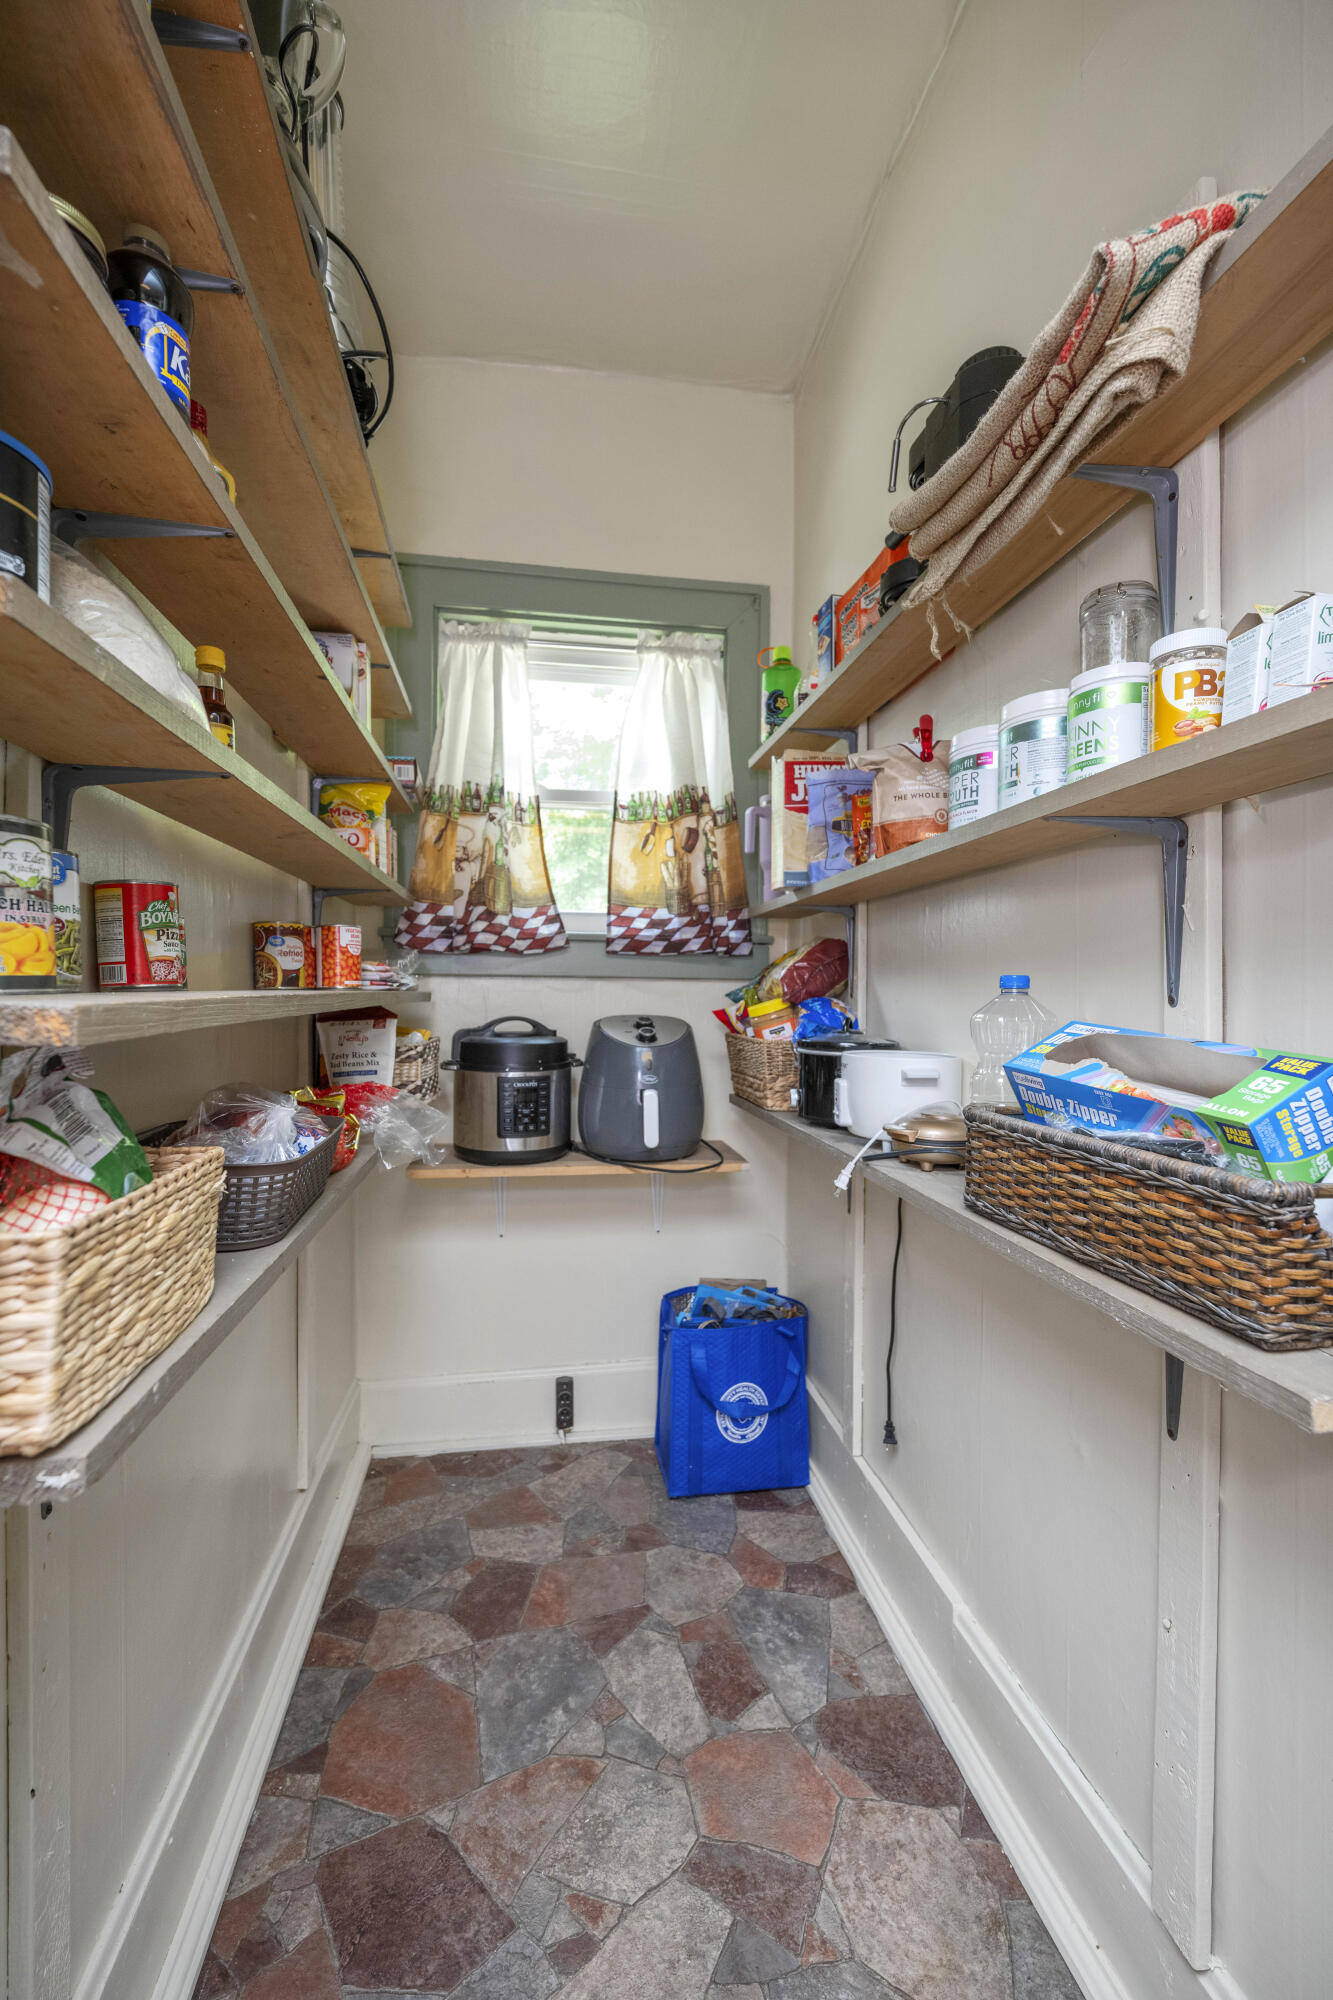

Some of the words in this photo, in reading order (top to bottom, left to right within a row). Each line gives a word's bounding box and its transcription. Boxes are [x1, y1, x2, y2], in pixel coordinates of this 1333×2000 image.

[1074, 715, 1120, 742] INNY
[1070, 735, 1119, 760] REENS
[953, 771, 979, 788] PER
[910, 792, 940, 800] WHOLE
[950, 785, 979, 804] OUTH
[328, 807, 369, 823] Macs
[147, 901, 168, 912] Chef
[4, 914, 17, 923] IN
[331, 1052, 349, 1060] Zesty
[351, 1051, 369, 1059] Rice
[366, 1059, 380, 1067] Mix
[1279, 1057, 1322, 1069] VALUE
[1270, 1062, 1311, 1076] PACK
[1247, 1076, 1291, 1094] 65
[1018, 1085, 1065, 1113] Double
[1066, 1098, 1119, 1128] Zipper
[1242, 1094, 1265, 1105] Bags
[1203, 1102, 1250, 1118] ALLON
[1305, 1086, 1333, 1145] Double
[1222, 1125, 1251, 1139] VALUE
[1289, 1097, 1322, 1151] Zipper
[1226, 1133, 1254, 1147] PACK
[1276, 1108, 1303, 1159] Storage
[1235, 1152, 1262, 1172] 65
